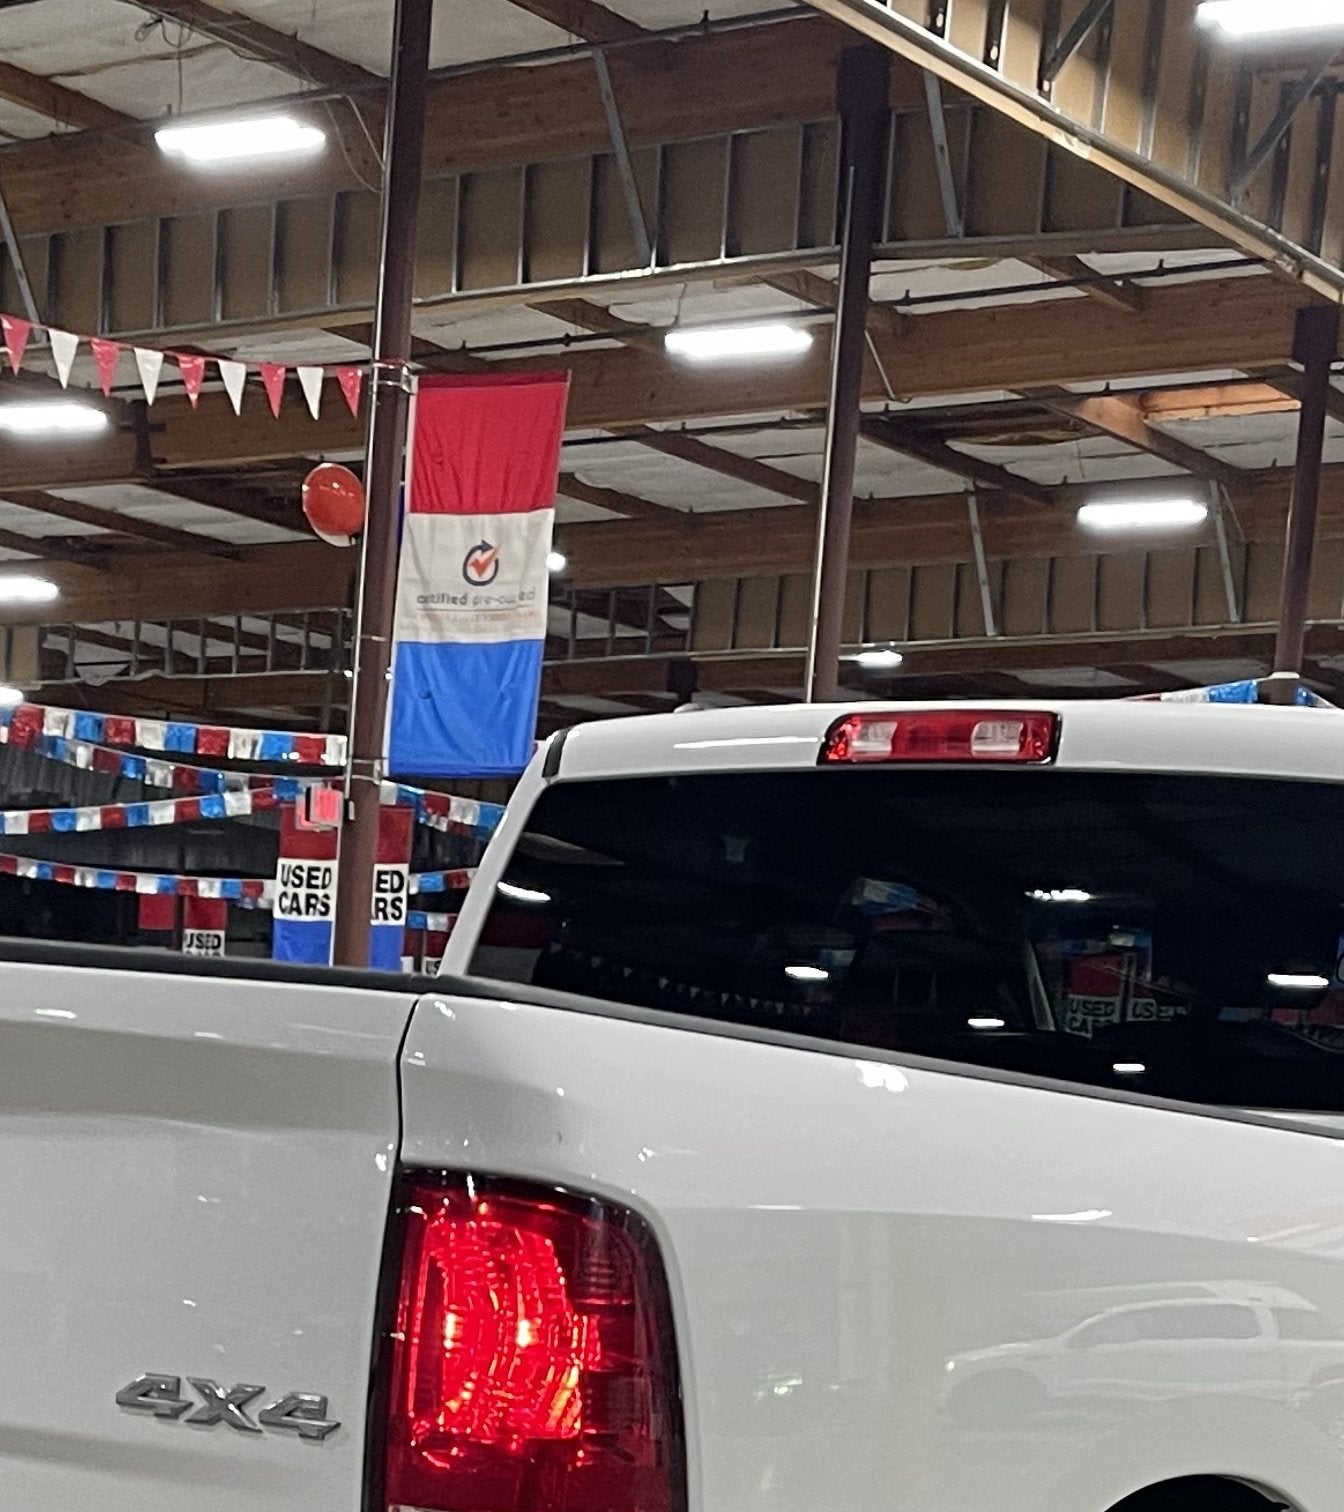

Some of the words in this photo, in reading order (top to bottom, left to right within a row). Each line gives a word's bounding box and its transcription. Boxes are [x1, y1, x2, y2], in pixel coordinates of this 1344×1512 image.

[281, 863, 332, 889] USED
[376, 870, 405, 893] ED
[278, 891, 331, 917] CARS
[374, 896, 403, 921] RS
[184, 933, 221, 949] USED
